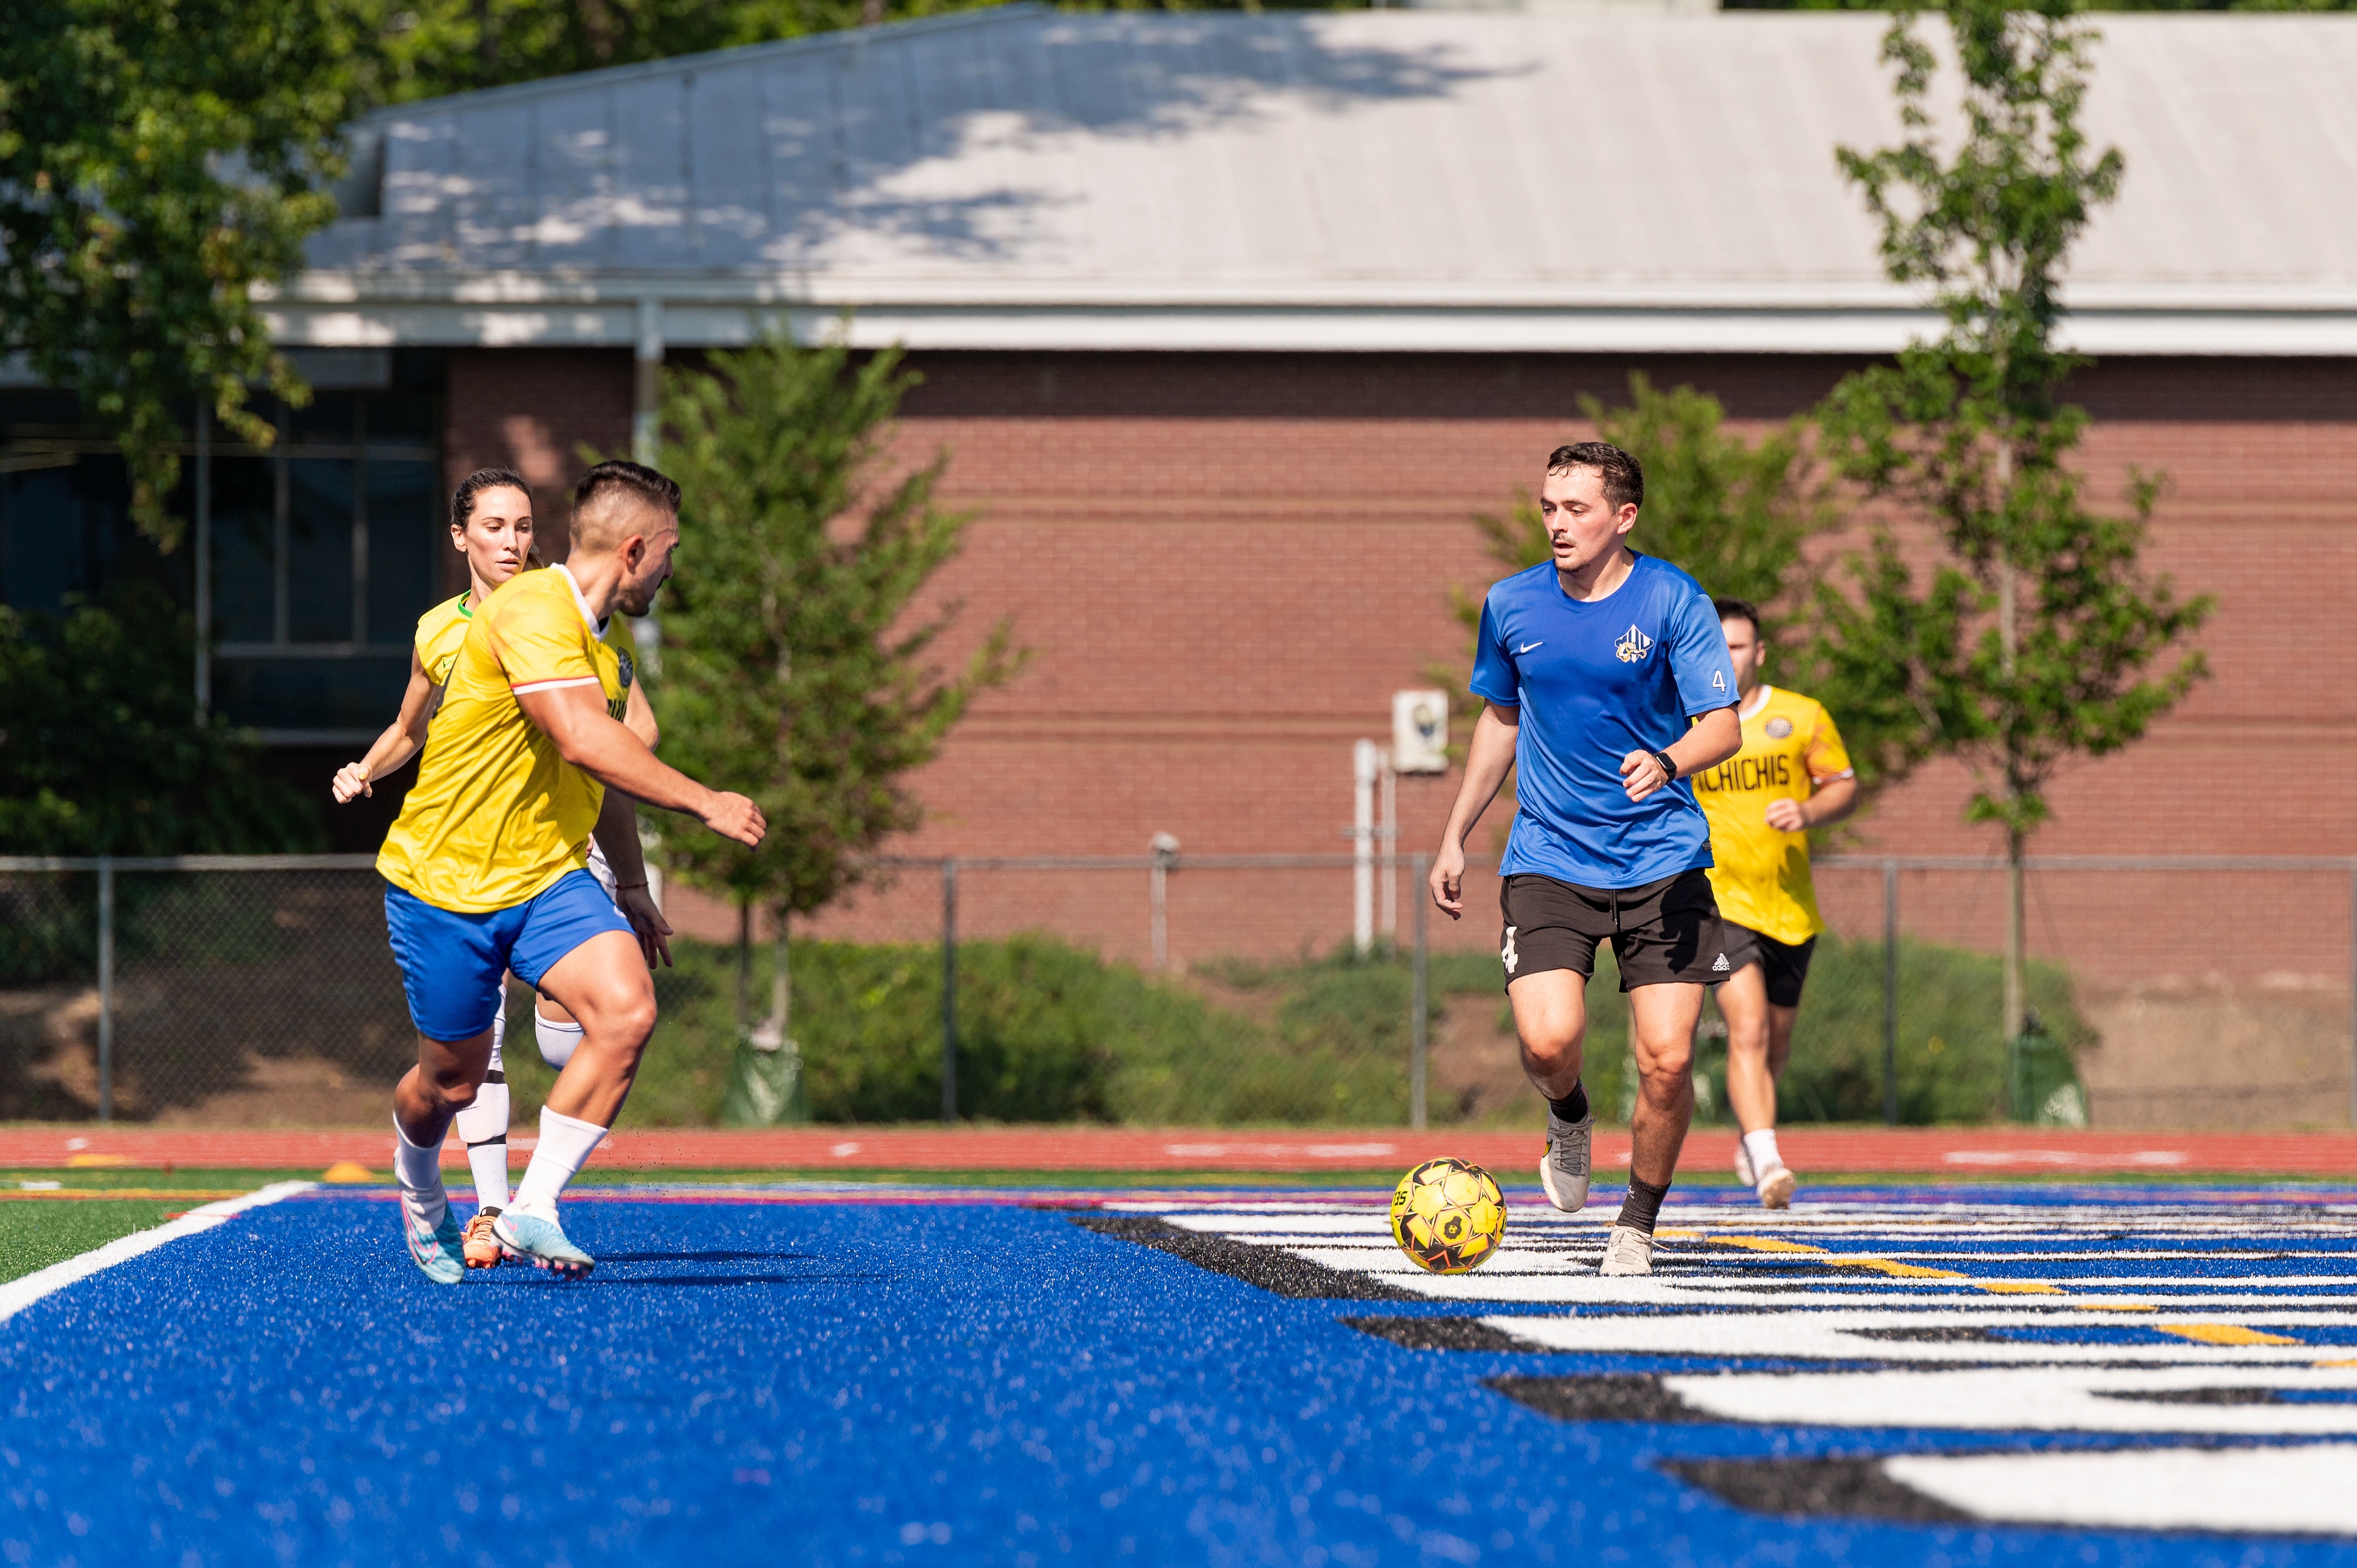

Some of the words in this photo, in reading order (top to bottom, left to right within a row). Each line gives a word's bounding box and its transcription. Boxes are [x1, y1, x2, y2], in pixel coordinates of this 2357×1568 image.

[1712, 670, 1726, 692] 4
[1690, 754, 1789, 792] ICHICHIS
[1501, 926, 1518, 974] 4
